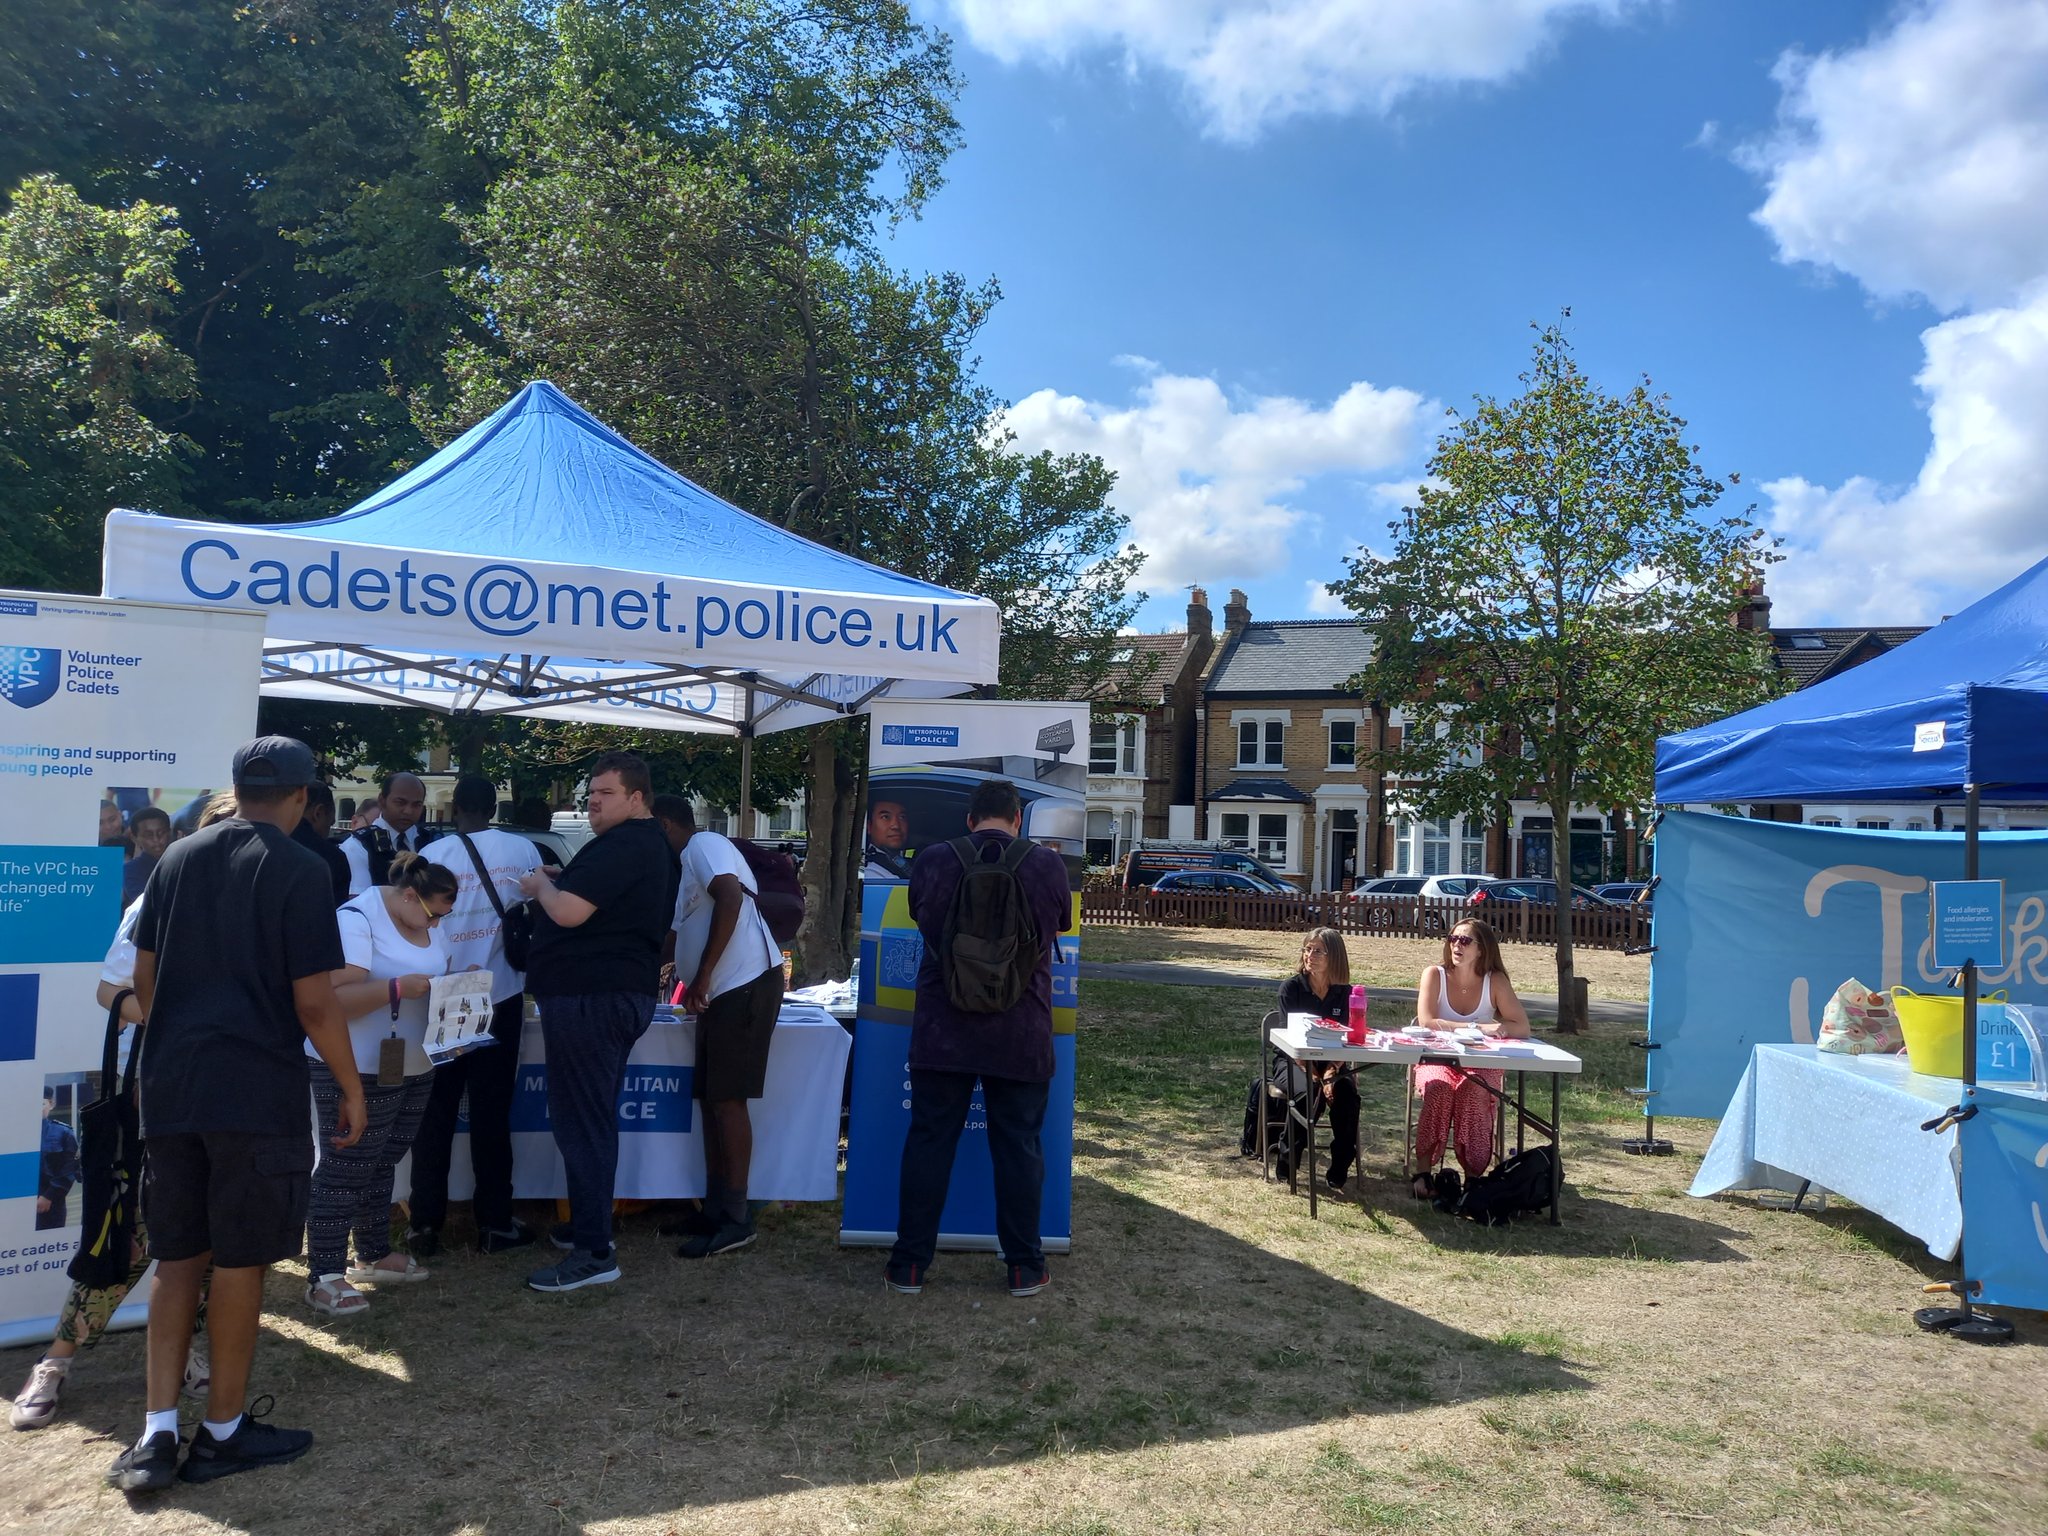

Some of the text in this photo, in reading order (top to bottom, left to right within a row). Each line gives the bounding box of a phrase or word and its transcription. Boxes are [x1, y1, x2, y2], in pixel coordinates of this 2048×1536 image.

[181, 539, 960, 655] Cadets@met.police.uk
[68, 649, 142, 667] Volunteer
[18, 648, 41, 689] VPC
[67, 665, 114, 680] Police
[66, 679, 120, 695] Cadets
[908, 728, 955, 736] METROPOLITAN
[0, 744, 176, 764] nspiring and supporting
[0, 762, 93, 778] oung people
[34, 862, 68, 875] VPC
[71, 863, 99, 876] has
[0, 881, 94, 897] changed my
[1947, 906, 1990, 915] Food allergies
[1981, 1020, 2023, 1036] Drink
[1991, 1041, 2015, 1068] £1
[21, 1241, 69, 1256] cadets
[0, 1259, 67, 1276] est of our
